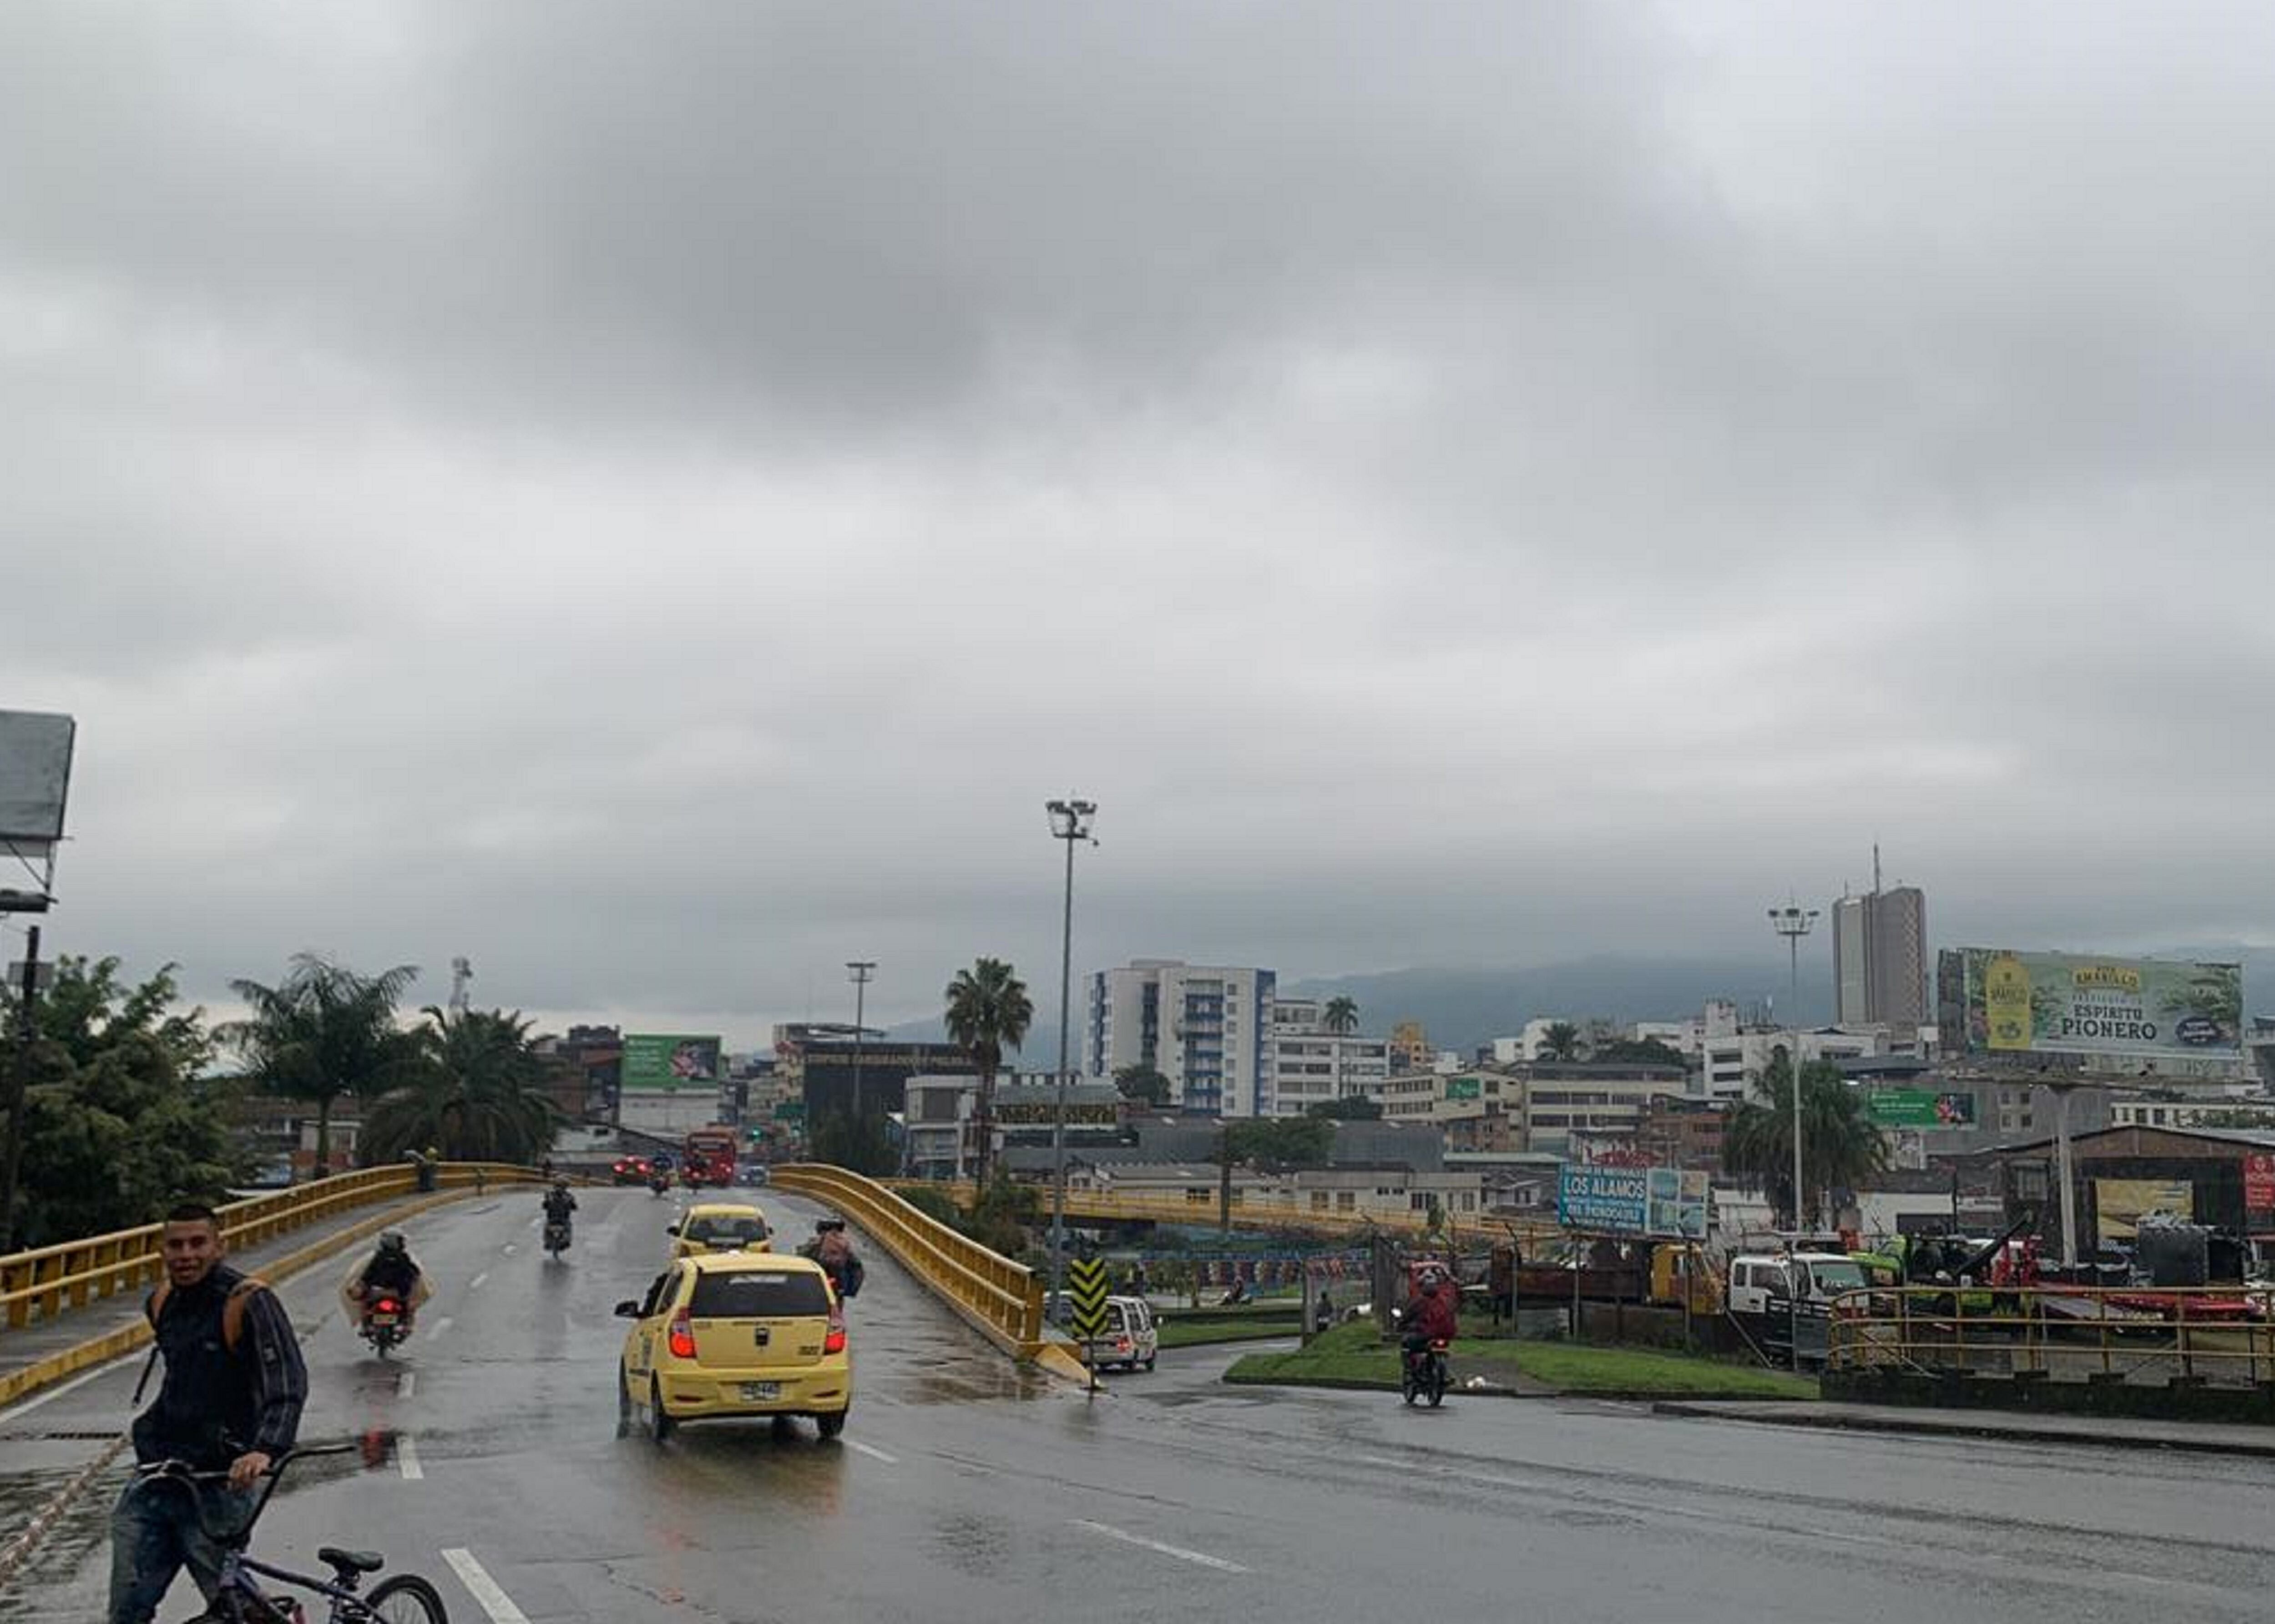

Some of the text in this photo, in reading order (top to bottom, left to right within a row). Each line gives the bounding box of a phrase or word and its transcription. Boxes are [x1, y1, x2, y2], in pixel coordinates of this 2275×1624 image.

[2062, 1018, 2157, 1040] PIONERO
[1564, 1176, 1645, 1199] LOS ALAMOS
